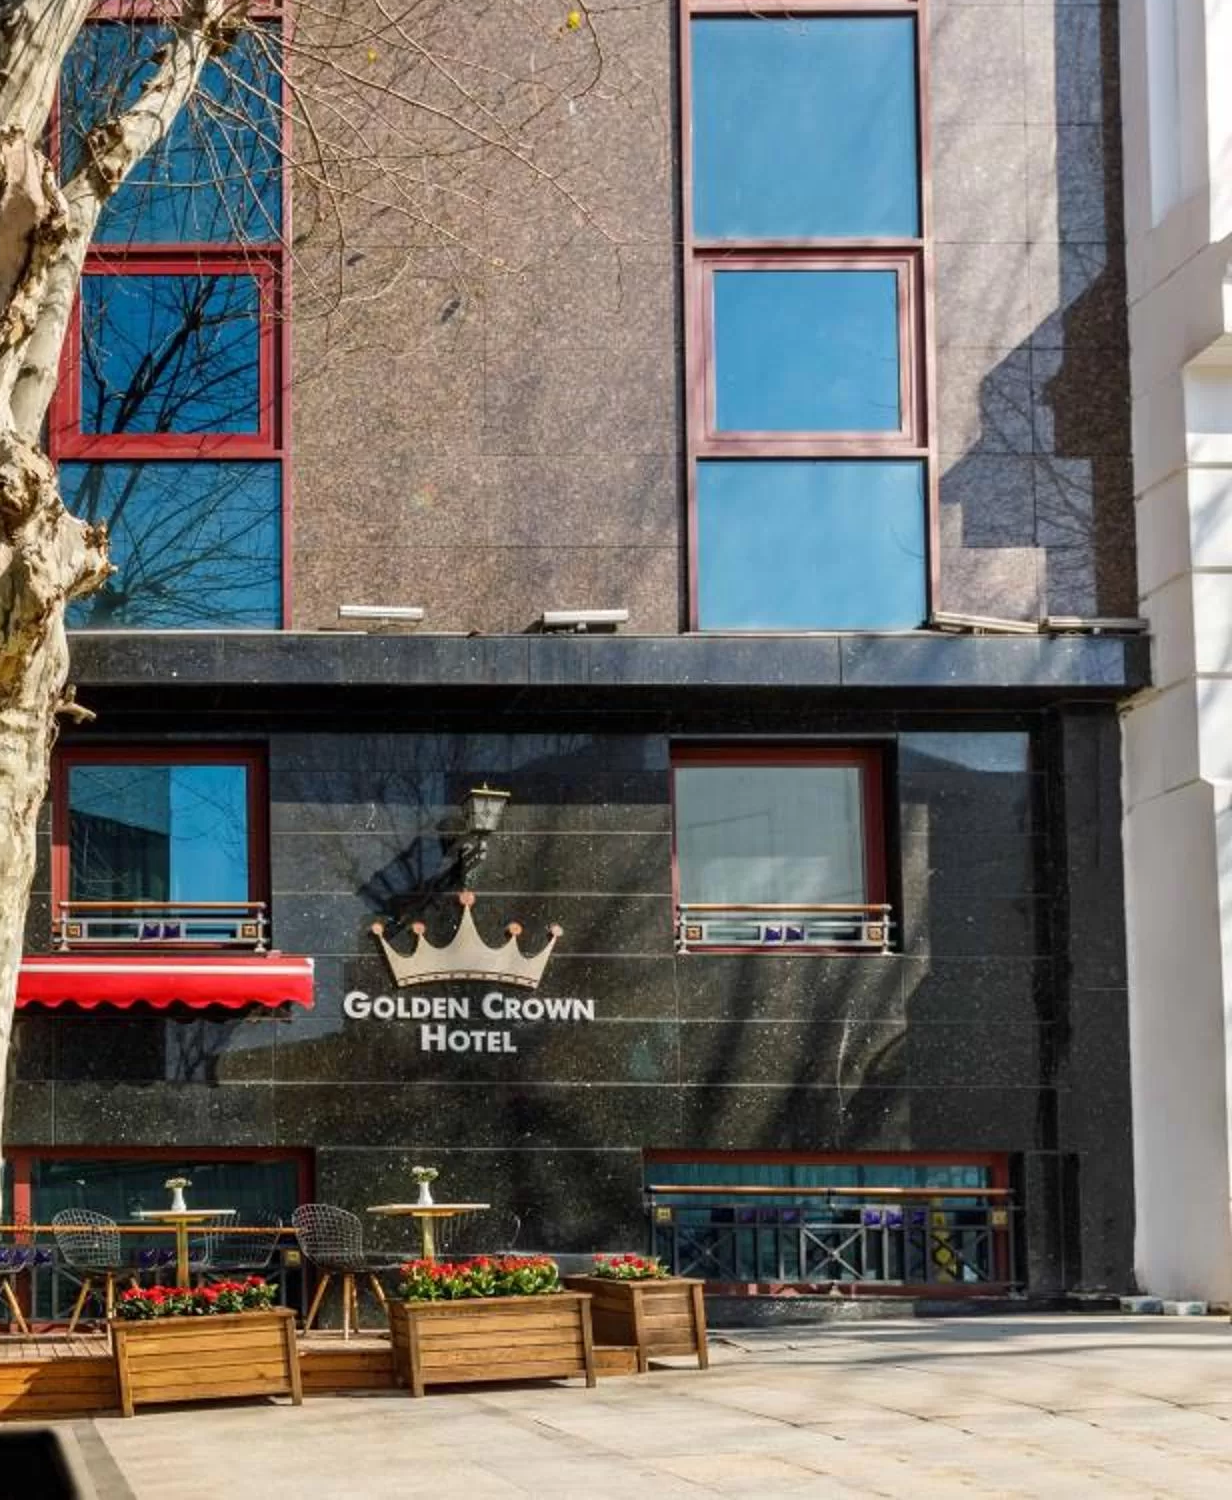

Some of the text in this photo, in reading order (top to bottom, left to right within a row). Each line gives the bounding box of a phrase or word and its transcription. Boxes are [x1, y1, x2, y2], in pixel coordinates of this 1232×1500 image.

[343, 990, 595, 1021] GOLDEN CROWN
[420, 1024, 517, 1052] HOTEL
